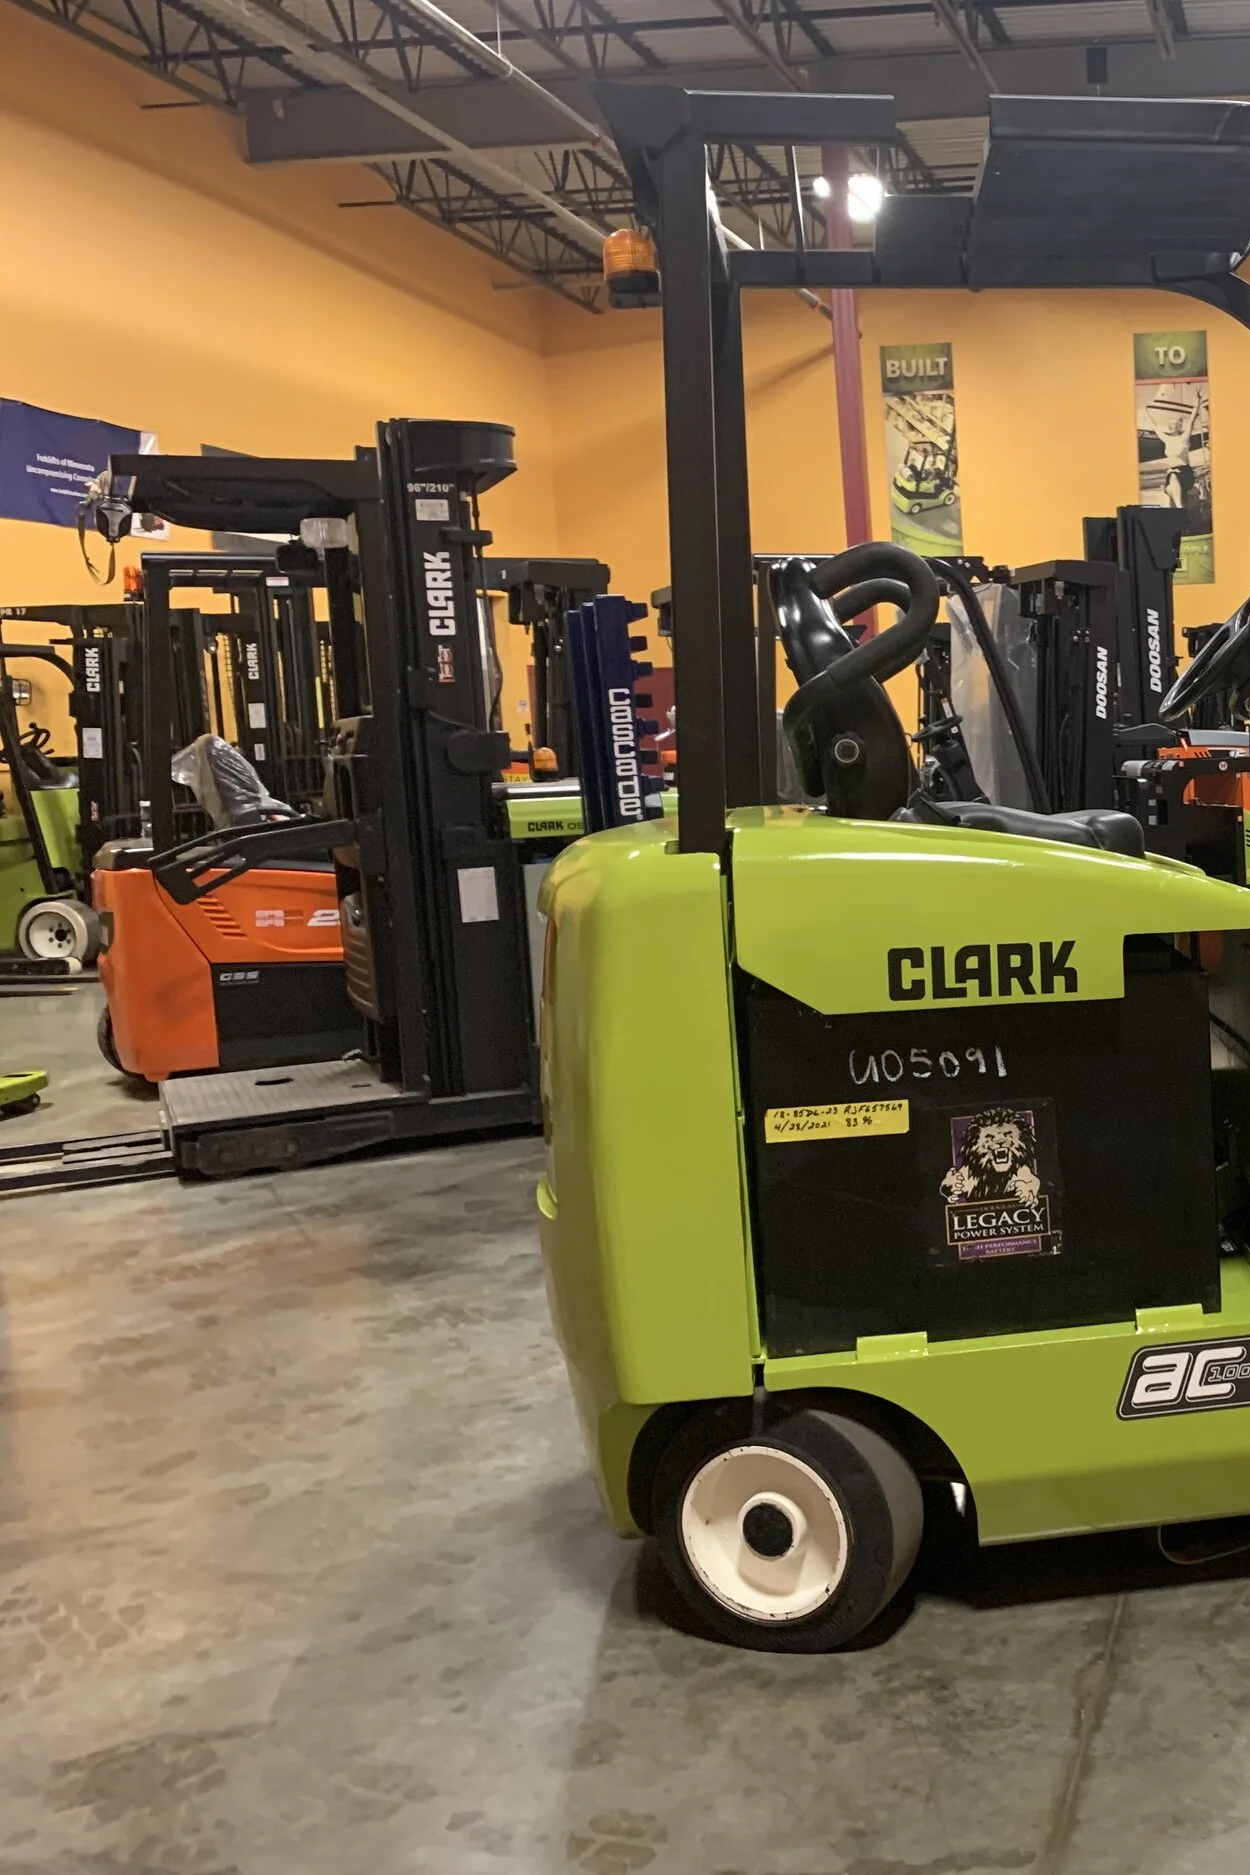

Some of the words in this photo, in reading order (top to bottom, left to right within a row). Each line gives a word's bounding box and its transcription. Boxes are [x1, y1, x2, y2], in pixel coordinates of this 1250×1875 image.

[886, 357, 948, 378] BUILT
[1155, 346, 1186, 366] TO
[423, 551, 457, 636] CLARK
[246, 643, 259, 680] CLARK
[1146, 608, 1163, 693] DOOSAN
[85, 647, 101, 692] CLARK
[1096, 646, 1108, 719] DOOSAN
[528, 820, 563, 832] CLARK
[888, 940, 1078, 1001] CLARK
[953, 1207, 1046, 1230] LEGACY
[954, 1229, 997, 1240] POWER
[1000, 1223, 1044, 1235] SYSTEM
[985, 1239, 1038, 1248] PERFORMANCE
